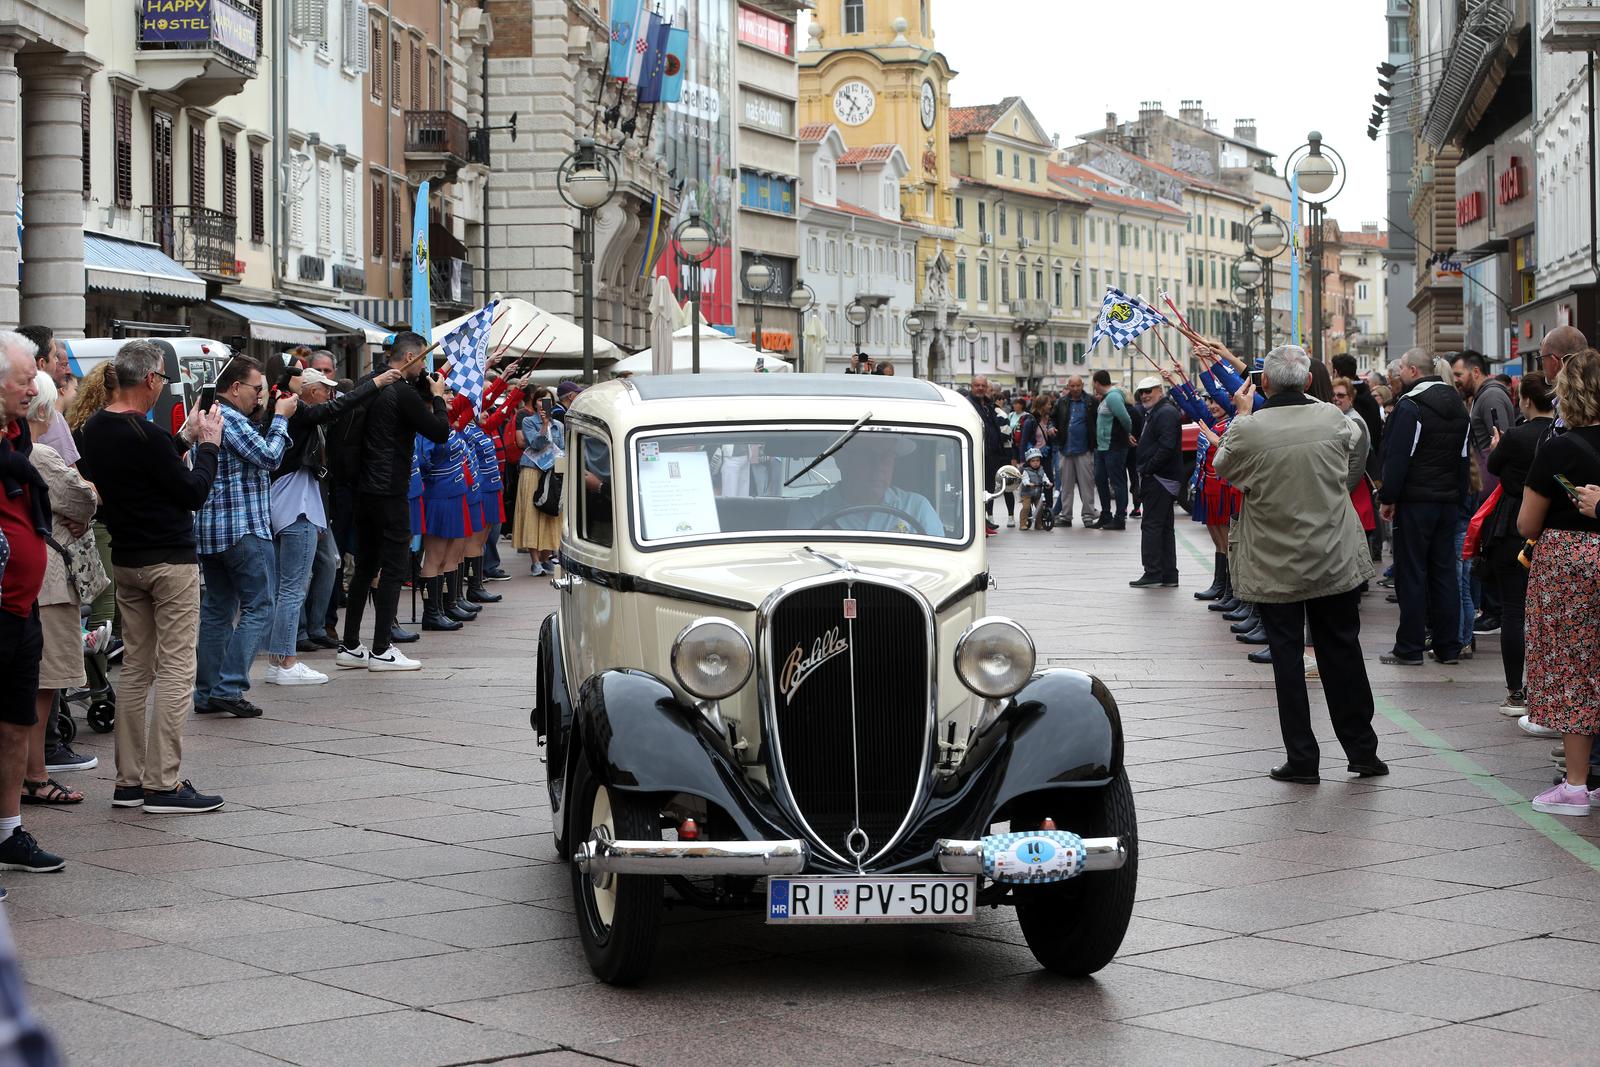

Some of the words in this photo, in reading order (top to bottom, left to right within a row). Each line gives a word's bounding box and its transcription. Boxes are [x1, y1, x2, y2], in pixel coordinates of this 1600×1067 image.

[147, 0, 206, 12] HAPPY
[144, 18, 209, 30] HOSTEL
[780, 625, 848, 704] Balilla
[1027, 842, 1044, 855] 10
[792, 885, 823, 915] RI
[856, 883, 969, 915] PV-508
[772, 905, 787, 914] HR
